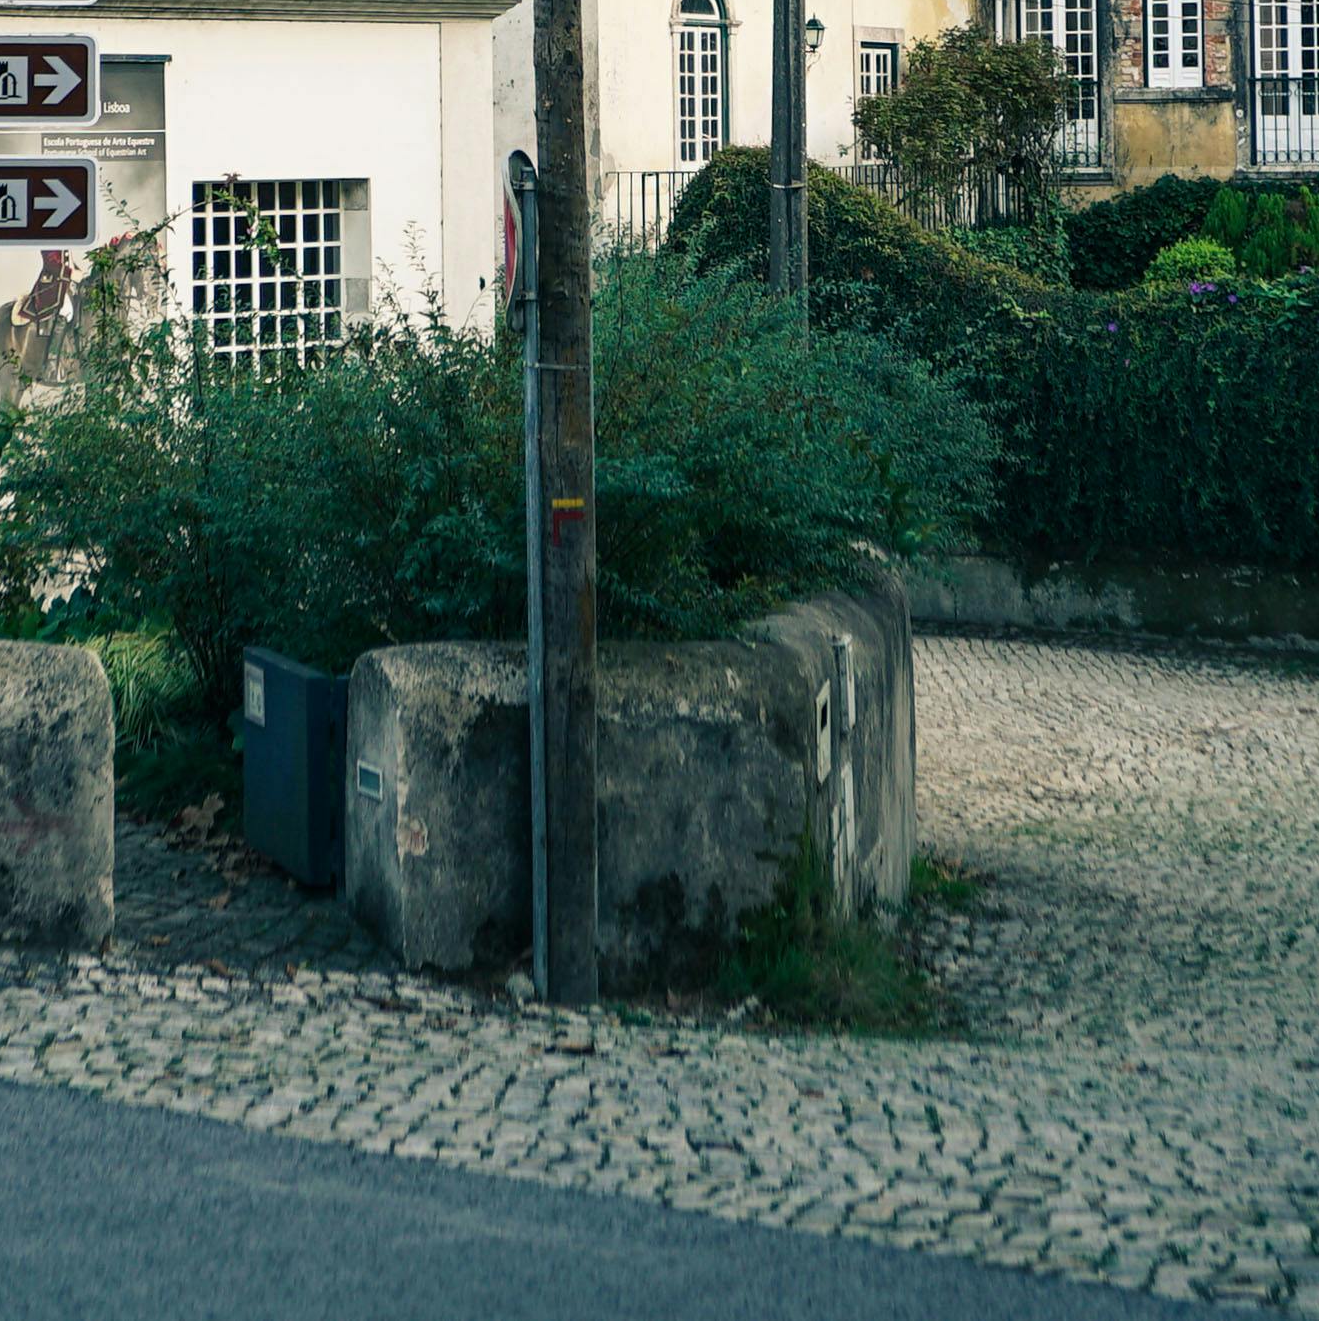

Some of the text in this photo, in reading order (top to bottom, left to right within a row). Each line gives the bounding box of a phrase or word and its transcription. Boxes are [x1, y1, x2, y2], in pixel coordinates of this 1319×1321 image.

[103, 101, 130, 114] Lisboa
[43, 137, 155, 149] Escola Portuguesa de Arte Equestre
